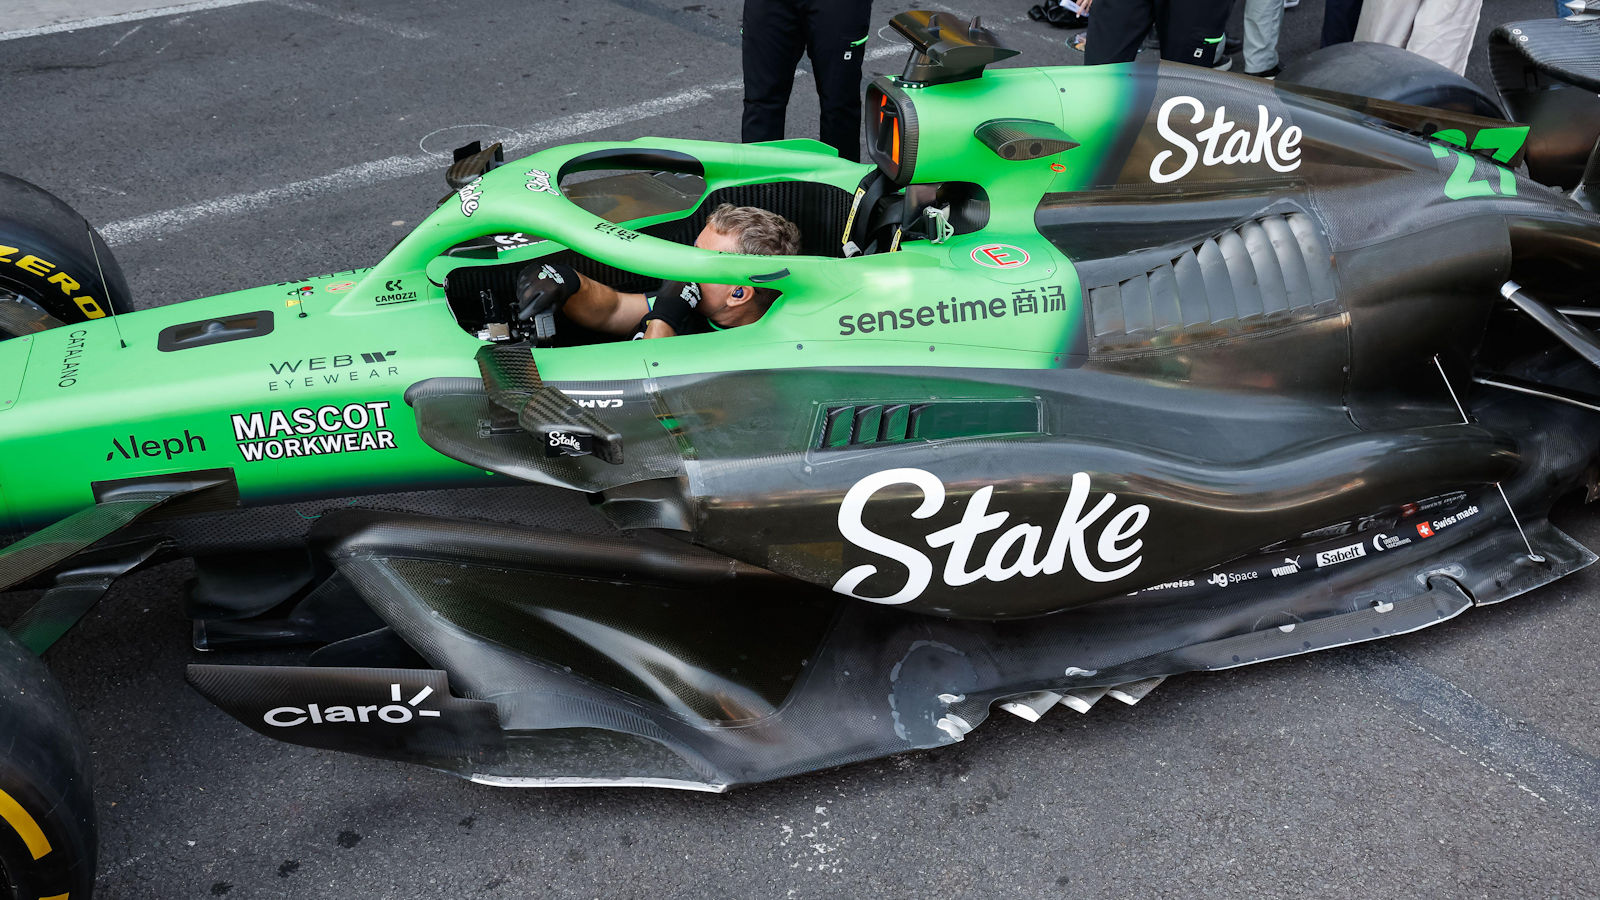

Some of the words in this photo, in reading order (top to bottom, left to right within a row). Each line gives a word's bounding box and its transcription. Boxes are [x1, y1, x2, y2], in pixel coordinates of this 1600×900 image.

[1149, 96, 1302, 183] Stake
[1429, 126, 1531, 200] 27
[374, 290, 418, 303] CAMOZZI
[839, 297, 1007, 336] sensetime
[1012, 285, 1067, 316] 商汤
[58, 329, 88, 389] CATALANO
[269, 354, 354, 375] WEB
[268, 366, 399, 392] EYEWEAR
[230, 401, 390, 441] MASCOT
[106, 429, 206, 462] Aleph
[236, 430, 398, 462] WORKWEAR
[548, 431, 581, 451] Stake
[1432, 517, 1457, 531] Swiss
[1455, 505, 1479, 521] made
[832, 467, 1150, 605] Stake
[1322, 546, 1361, 565] Sabelt
[263, 703, 413, 727] Claro
